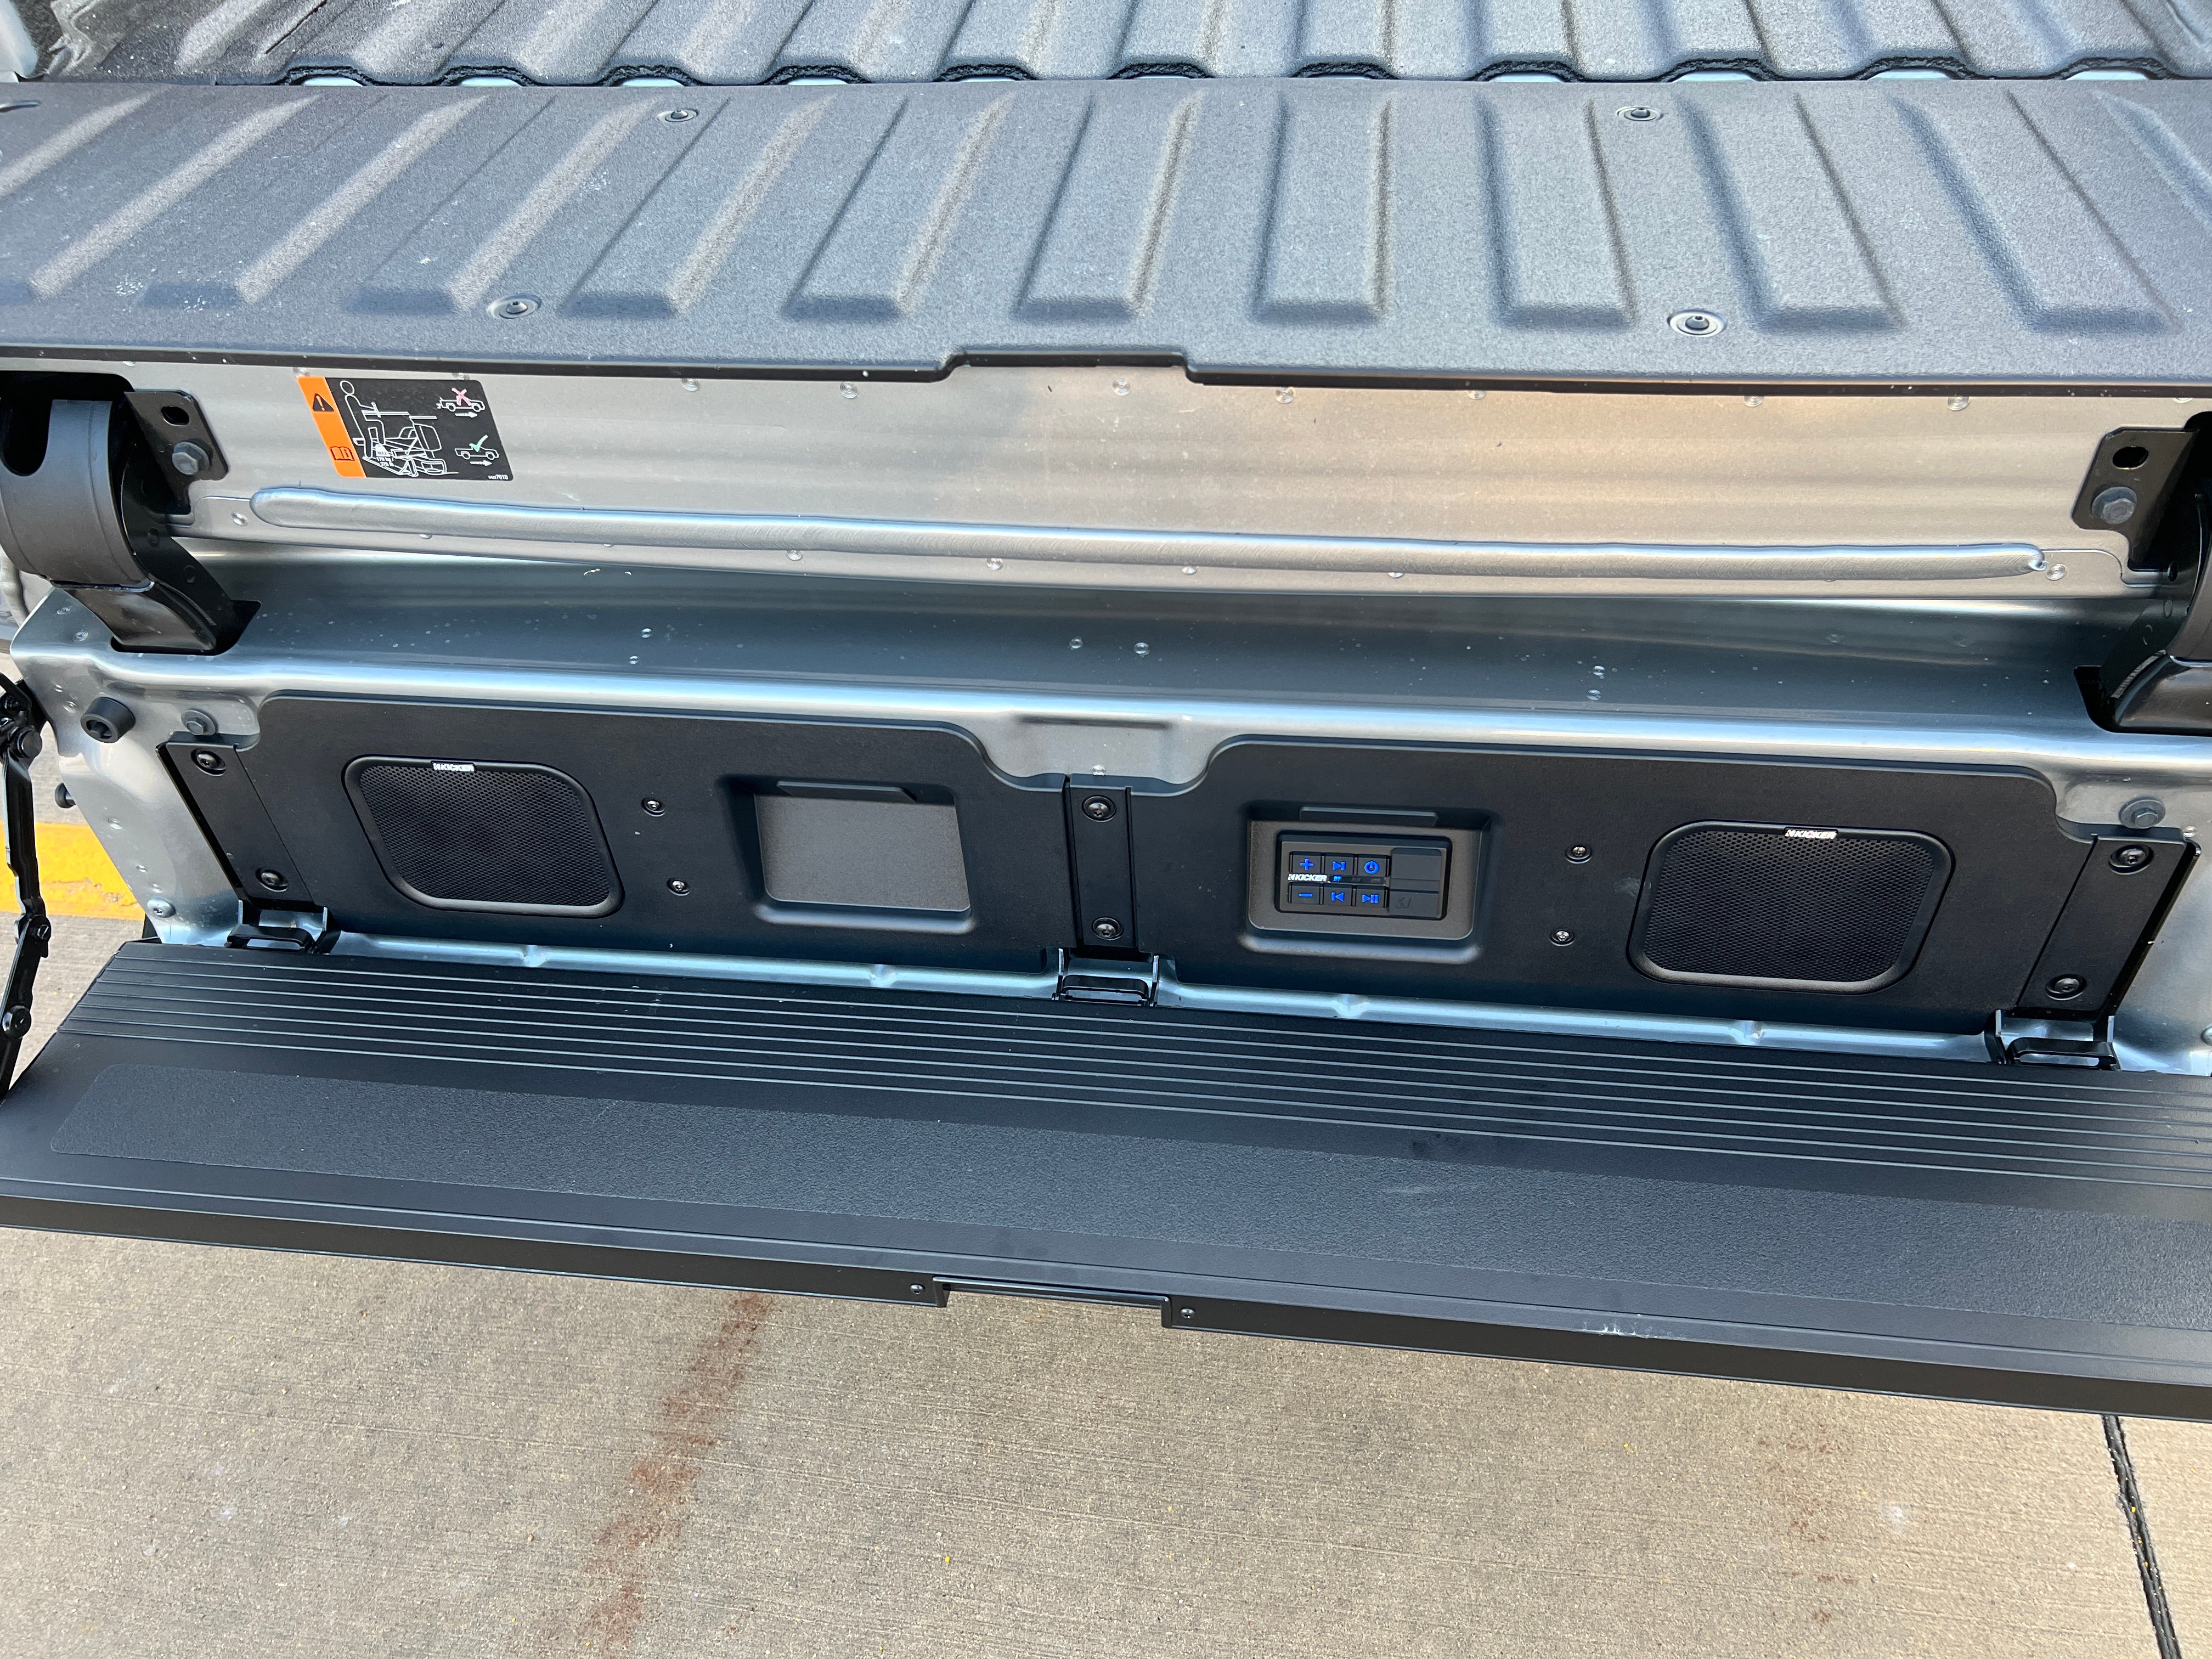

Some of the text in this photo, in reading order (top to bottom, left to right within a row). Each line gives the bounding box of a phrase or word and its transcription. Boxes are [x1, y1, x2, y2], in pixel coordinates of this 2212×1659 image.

[441, 763, 475, 772] KICKER
[1793, 830, 1837, 839] KICKER
[1295, 873, 1328, 882] KICKER
